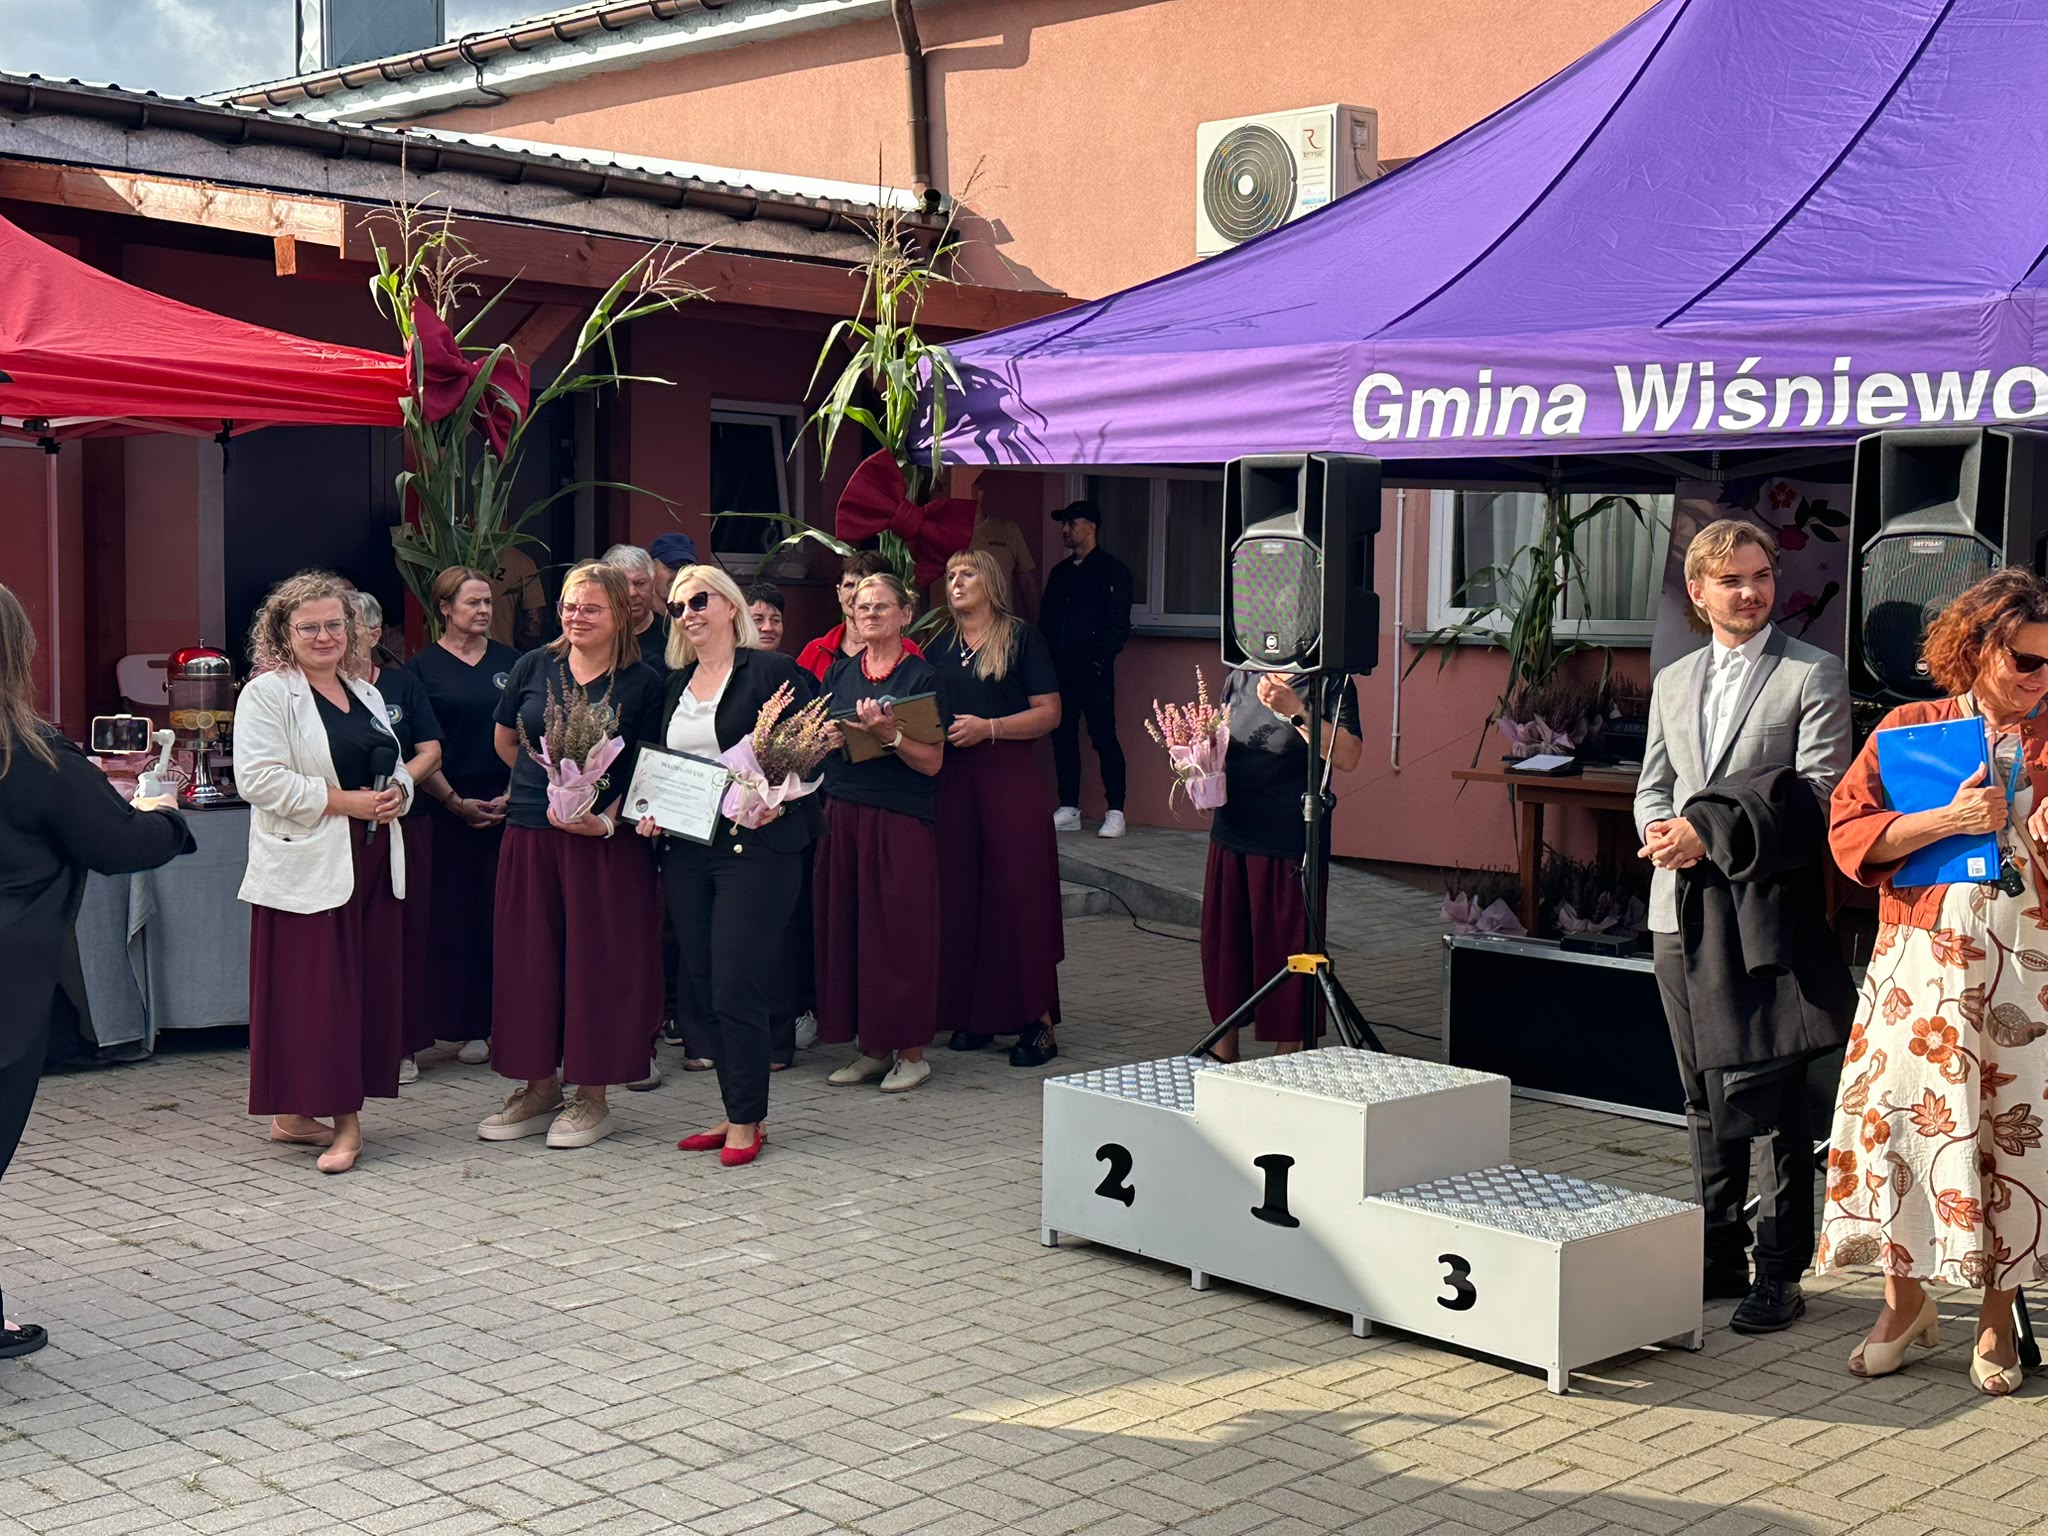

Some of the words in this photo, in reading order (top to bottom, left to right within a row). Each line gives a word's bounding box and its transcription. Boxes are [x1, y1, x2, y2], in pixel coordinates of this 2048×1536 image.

[1352, 369, 1587, 442] Gmina
[1613, 356, 2048, 433] Wiśniewo
[1094, 1142, 1136, 1208] 2
[1250, 1153, 1301, 1229] 1
[1436, 1253, 1477, 1312] 3
